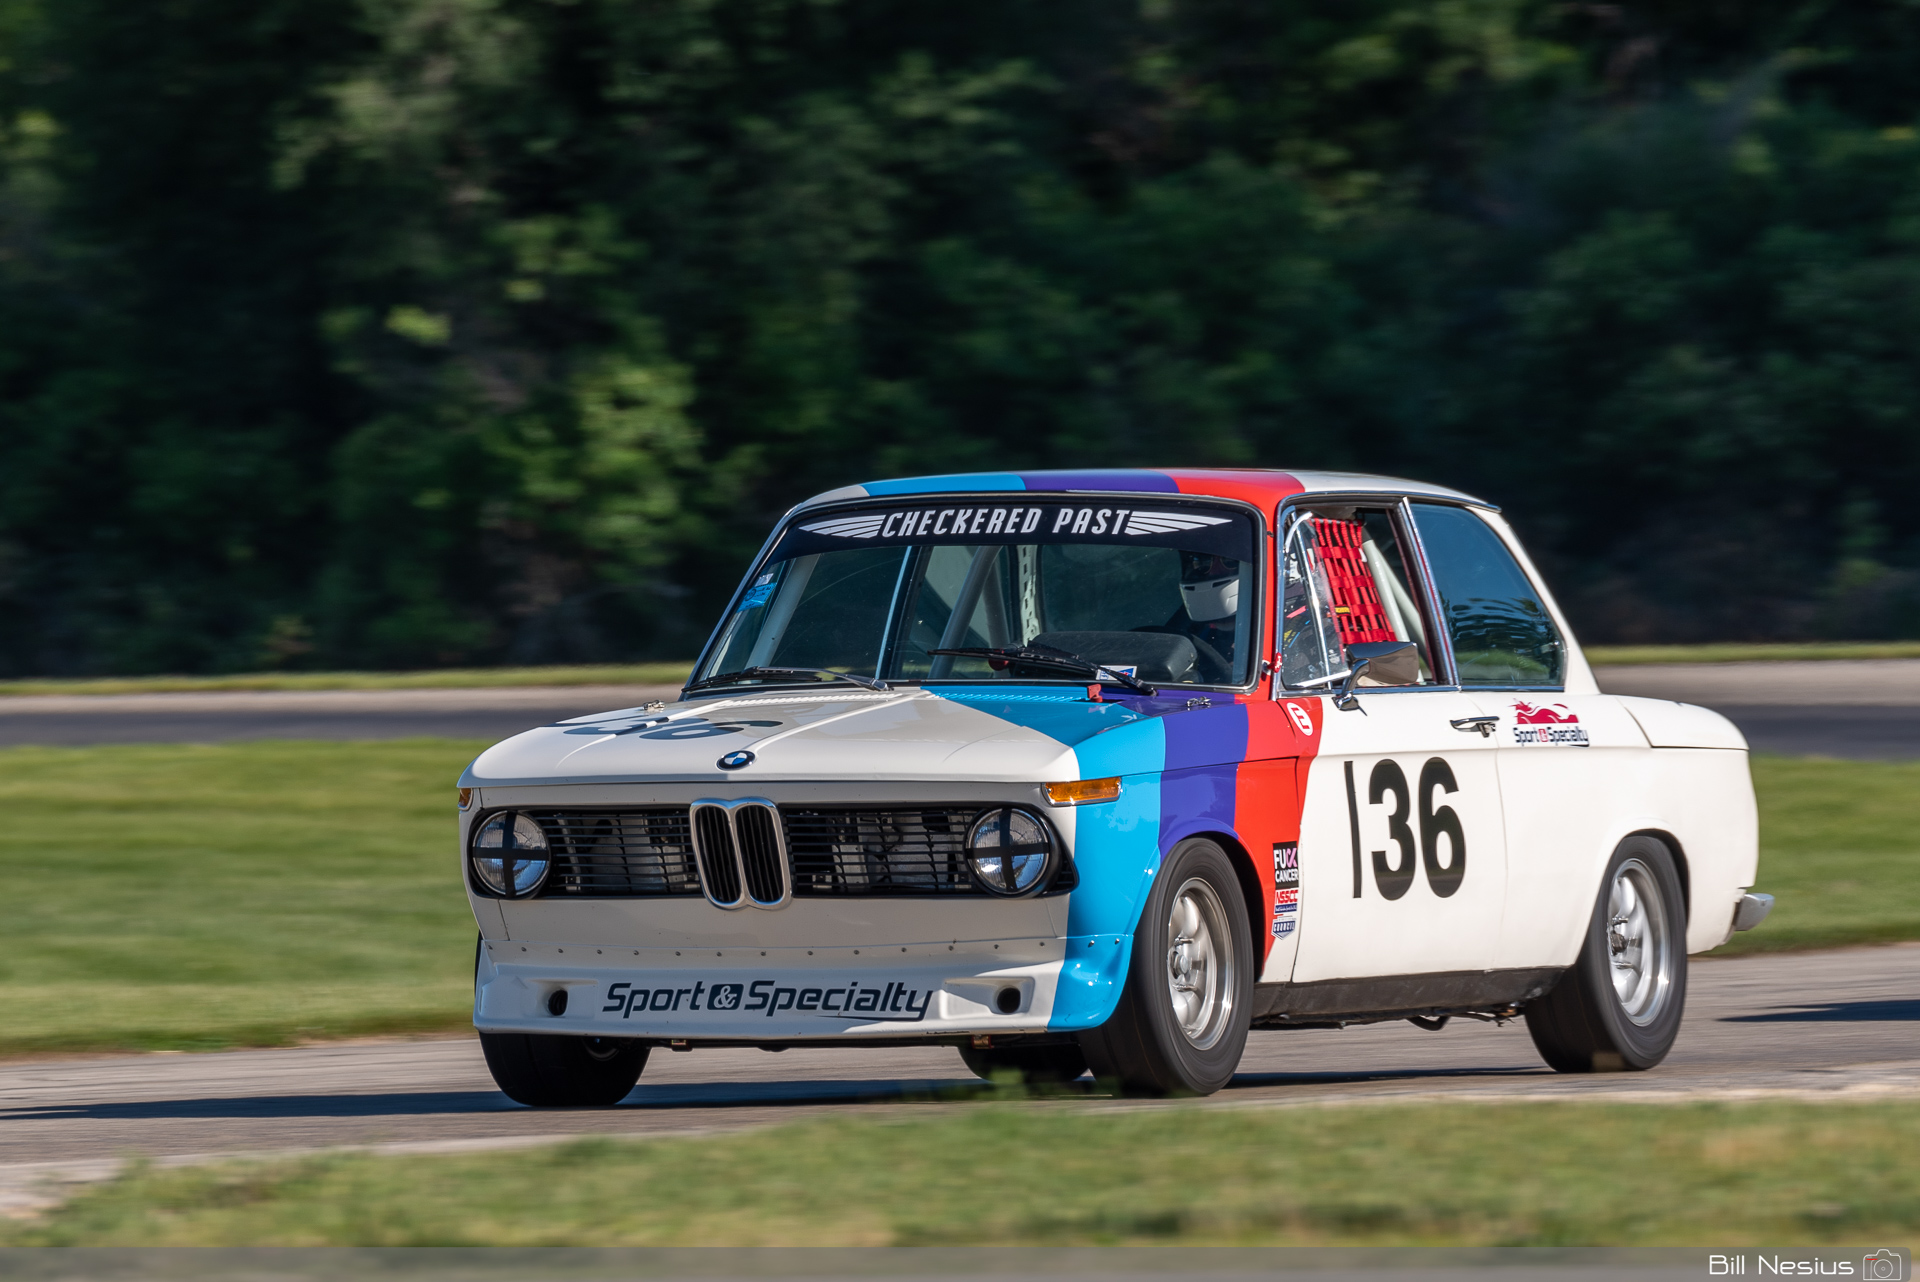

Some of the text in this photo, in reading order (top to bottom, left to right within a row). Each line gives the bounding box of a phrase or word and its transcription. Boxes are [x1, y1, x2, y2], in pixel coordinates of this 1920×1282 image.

[882, 507, 1130, 538] CHECKERED PAST
[1344, 756, 1466, 901] 136
[1275, 868, 1299, 883] CANCER
